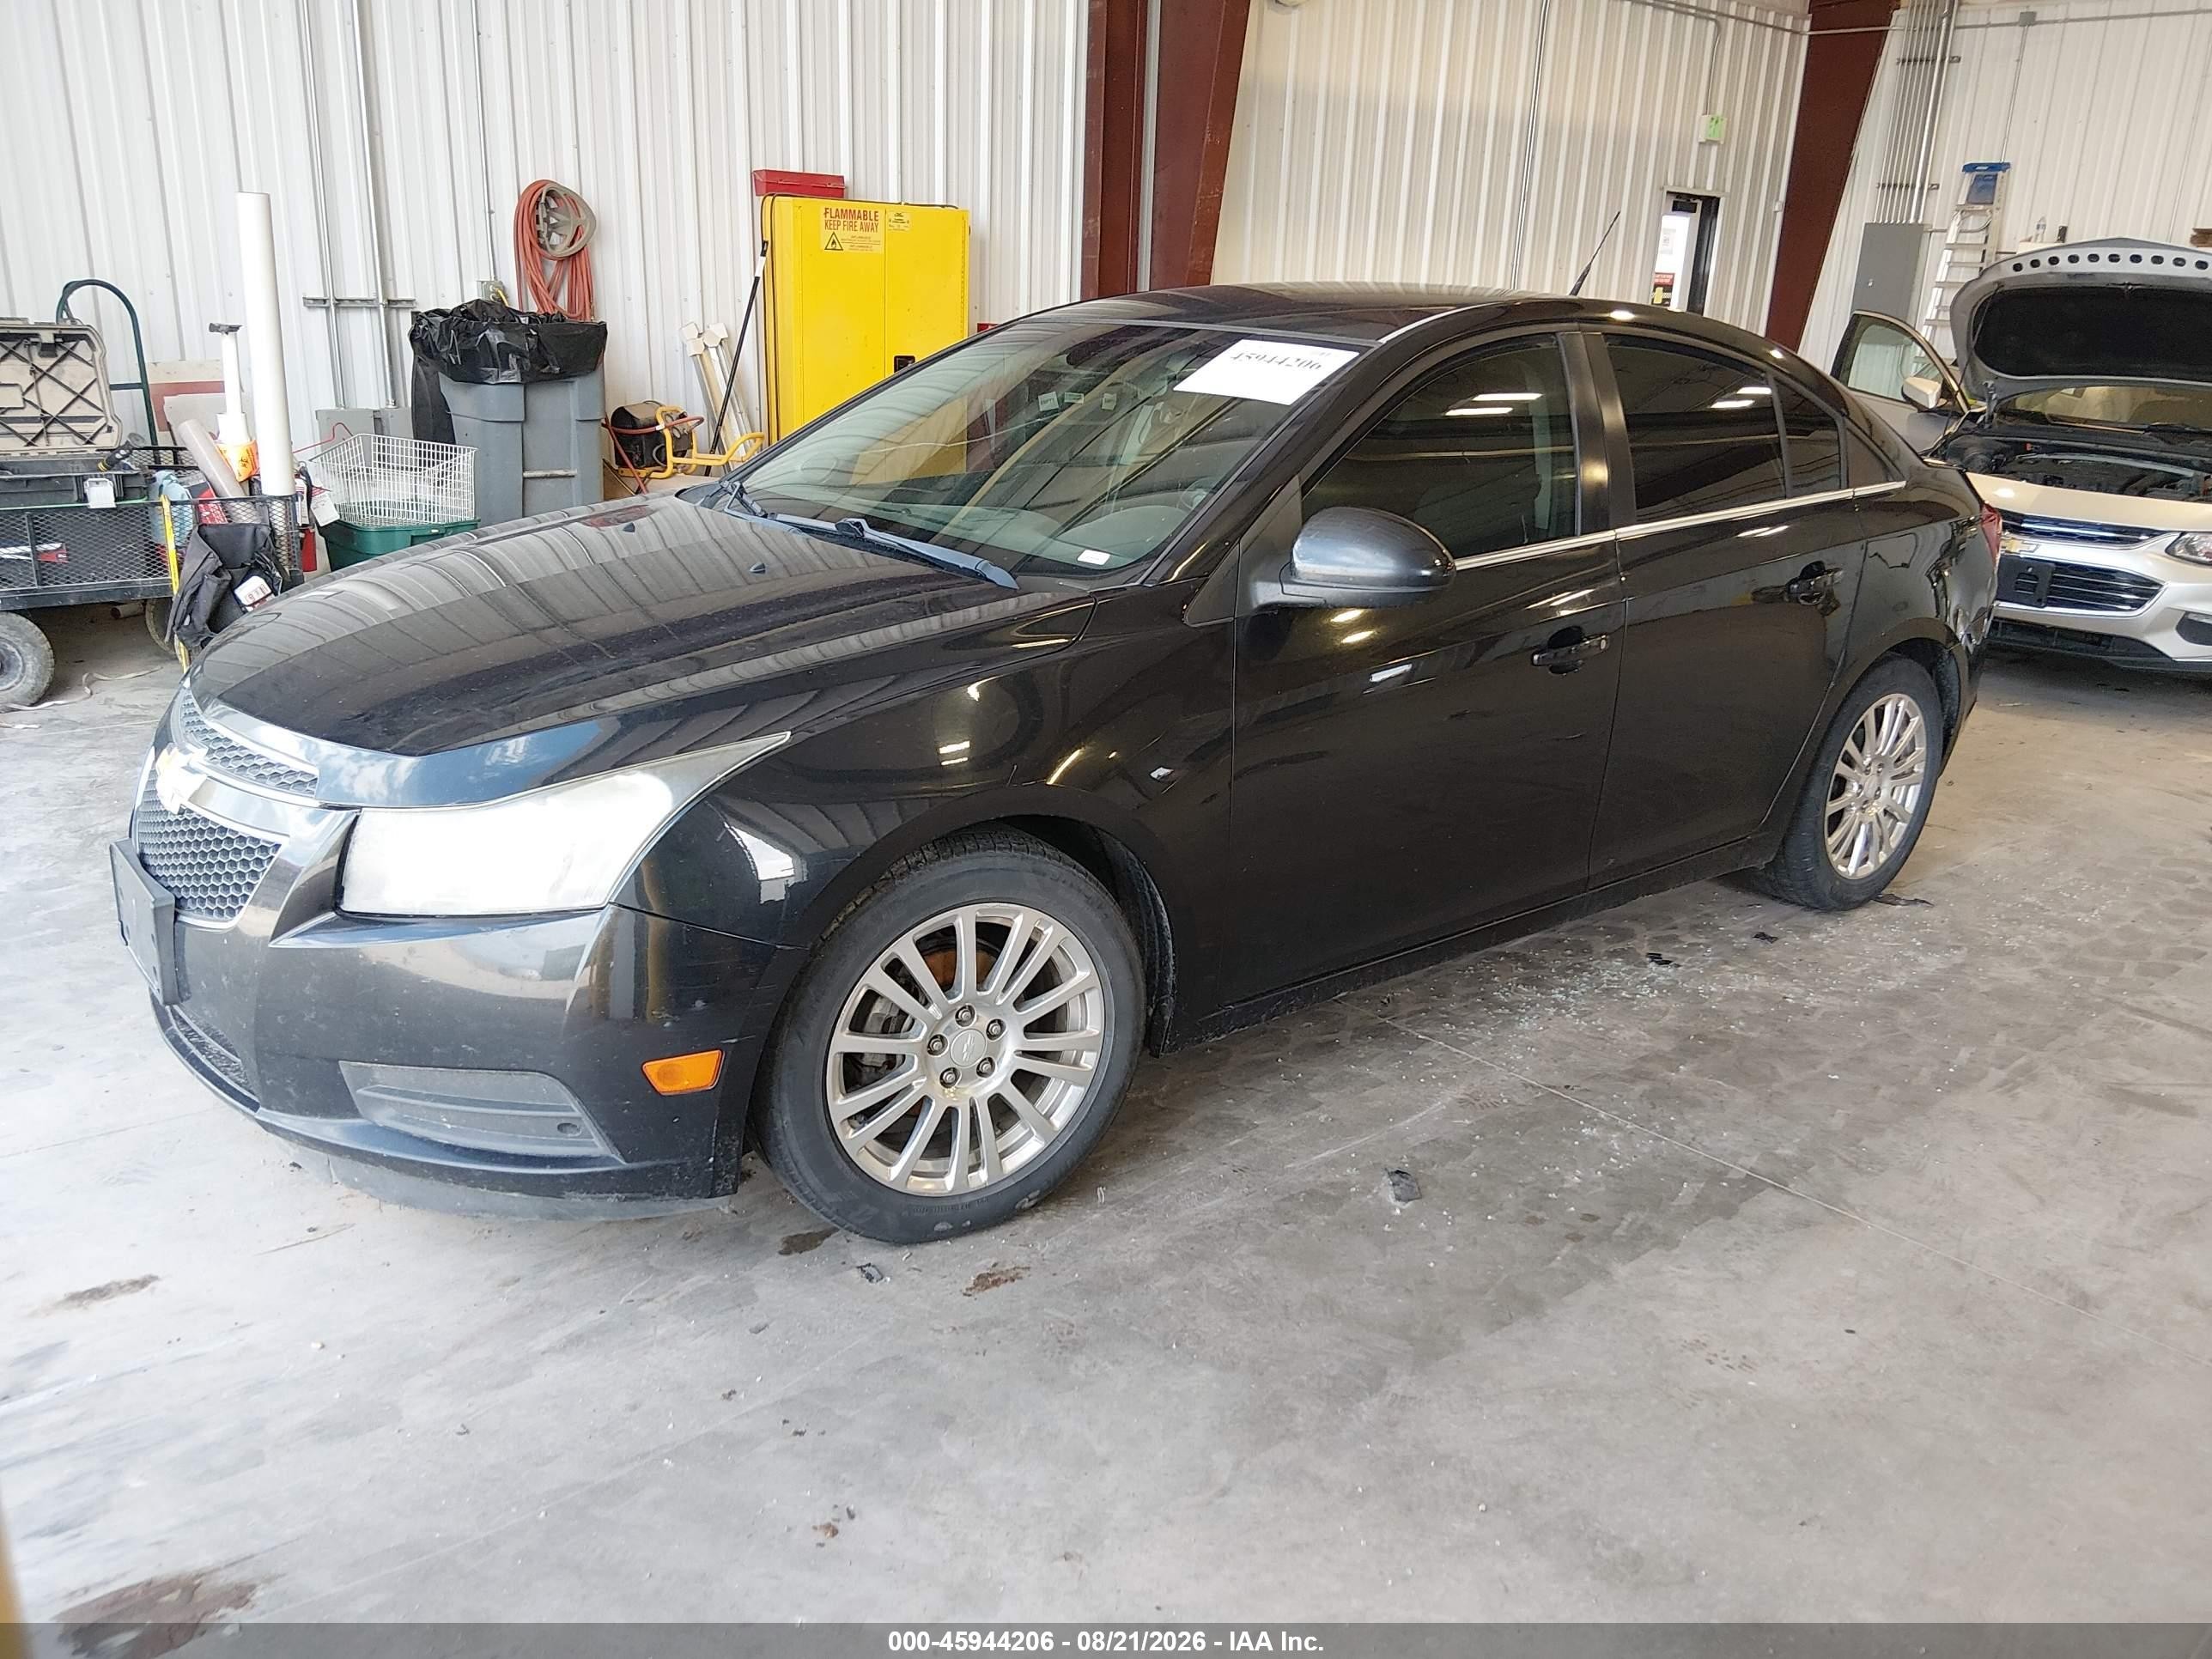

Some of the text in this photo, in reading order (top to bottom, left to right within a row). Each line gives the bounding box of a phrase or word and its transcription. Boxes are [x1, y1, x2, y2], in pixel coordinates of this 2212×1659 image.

[823, 207, 879, 222] FLAMMABLE
[824, 219, 879, 233] KEEP FIRE AWAY
